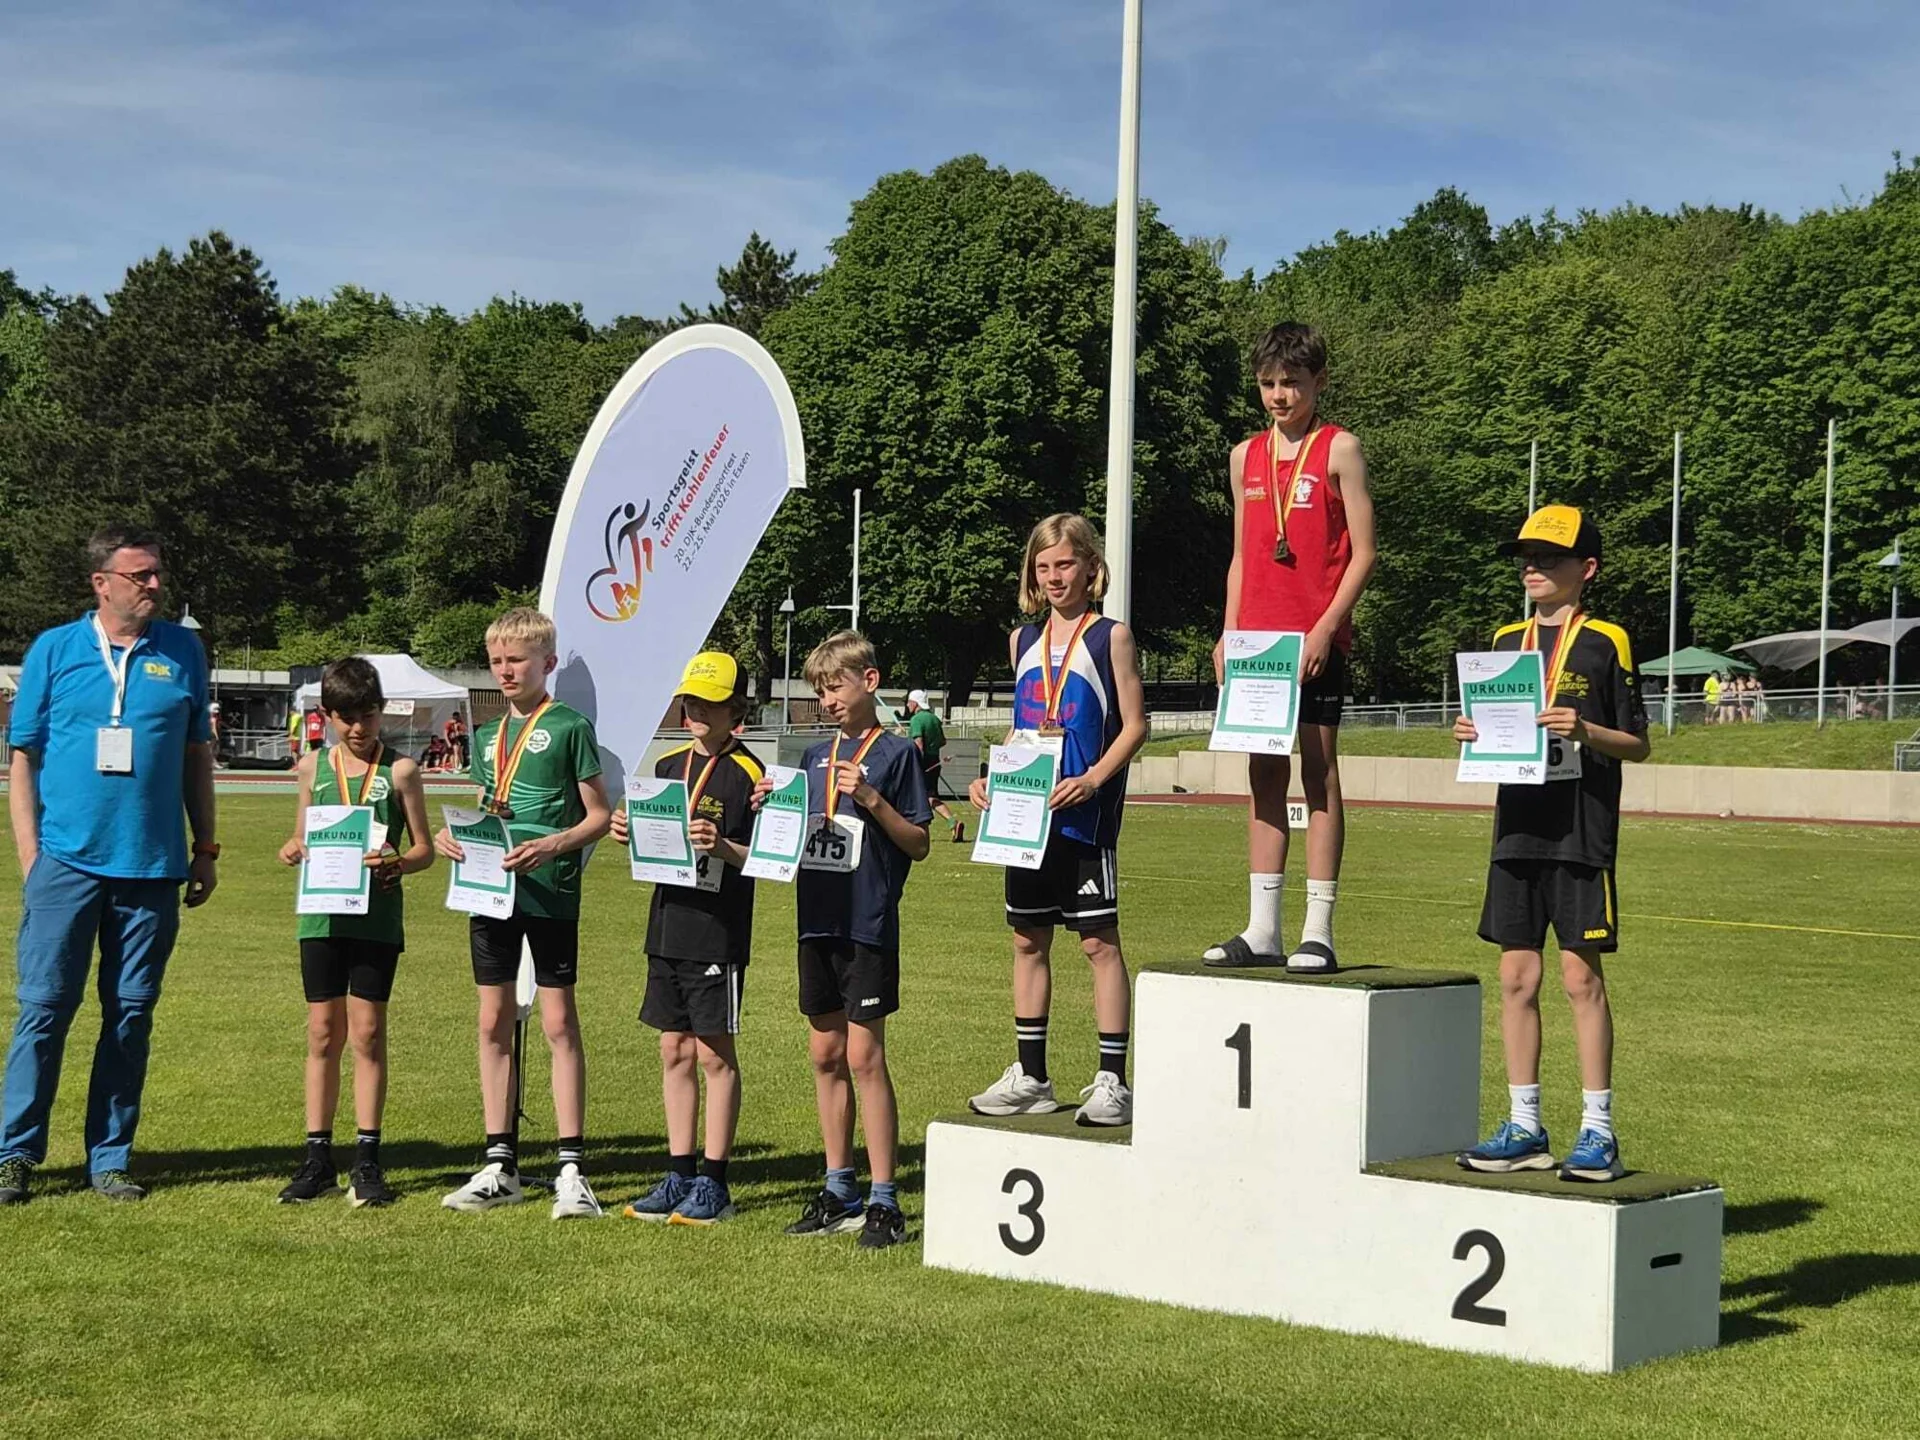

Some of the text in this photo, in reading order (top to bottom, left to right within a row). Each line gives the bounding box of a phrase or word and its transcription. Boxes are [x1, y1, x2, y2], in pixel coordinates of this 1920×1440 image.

[651, 449, 699, 531] Sportsgeist
[660, 423, 730, 548] trifft Kohlenfeuer
[683, 452, 738, 546] DJK-Bundessportfest
[703, 514, 717, 534] Mai
[726, 478, 737, 490] in
[732, 451, 751, 479] Essen
[1232, 660, 1292, 672] URKUNDE
[1469, 682, 1536, 694] URKUNDE
[995, 774, 1048, 789] URKUNDE
[632, 801, 683, 814] URKUNDE
[1290, 806, 1303, 822] 20
[310, 831, 364, 840] URKUNDE
[1583, 929, 1608, 940] JAKO
[1225, 1023, 1252, 1109] 1
[998, 1168, 1045, 1256] 3
[1451, 1229, 1507, 1327] 2
